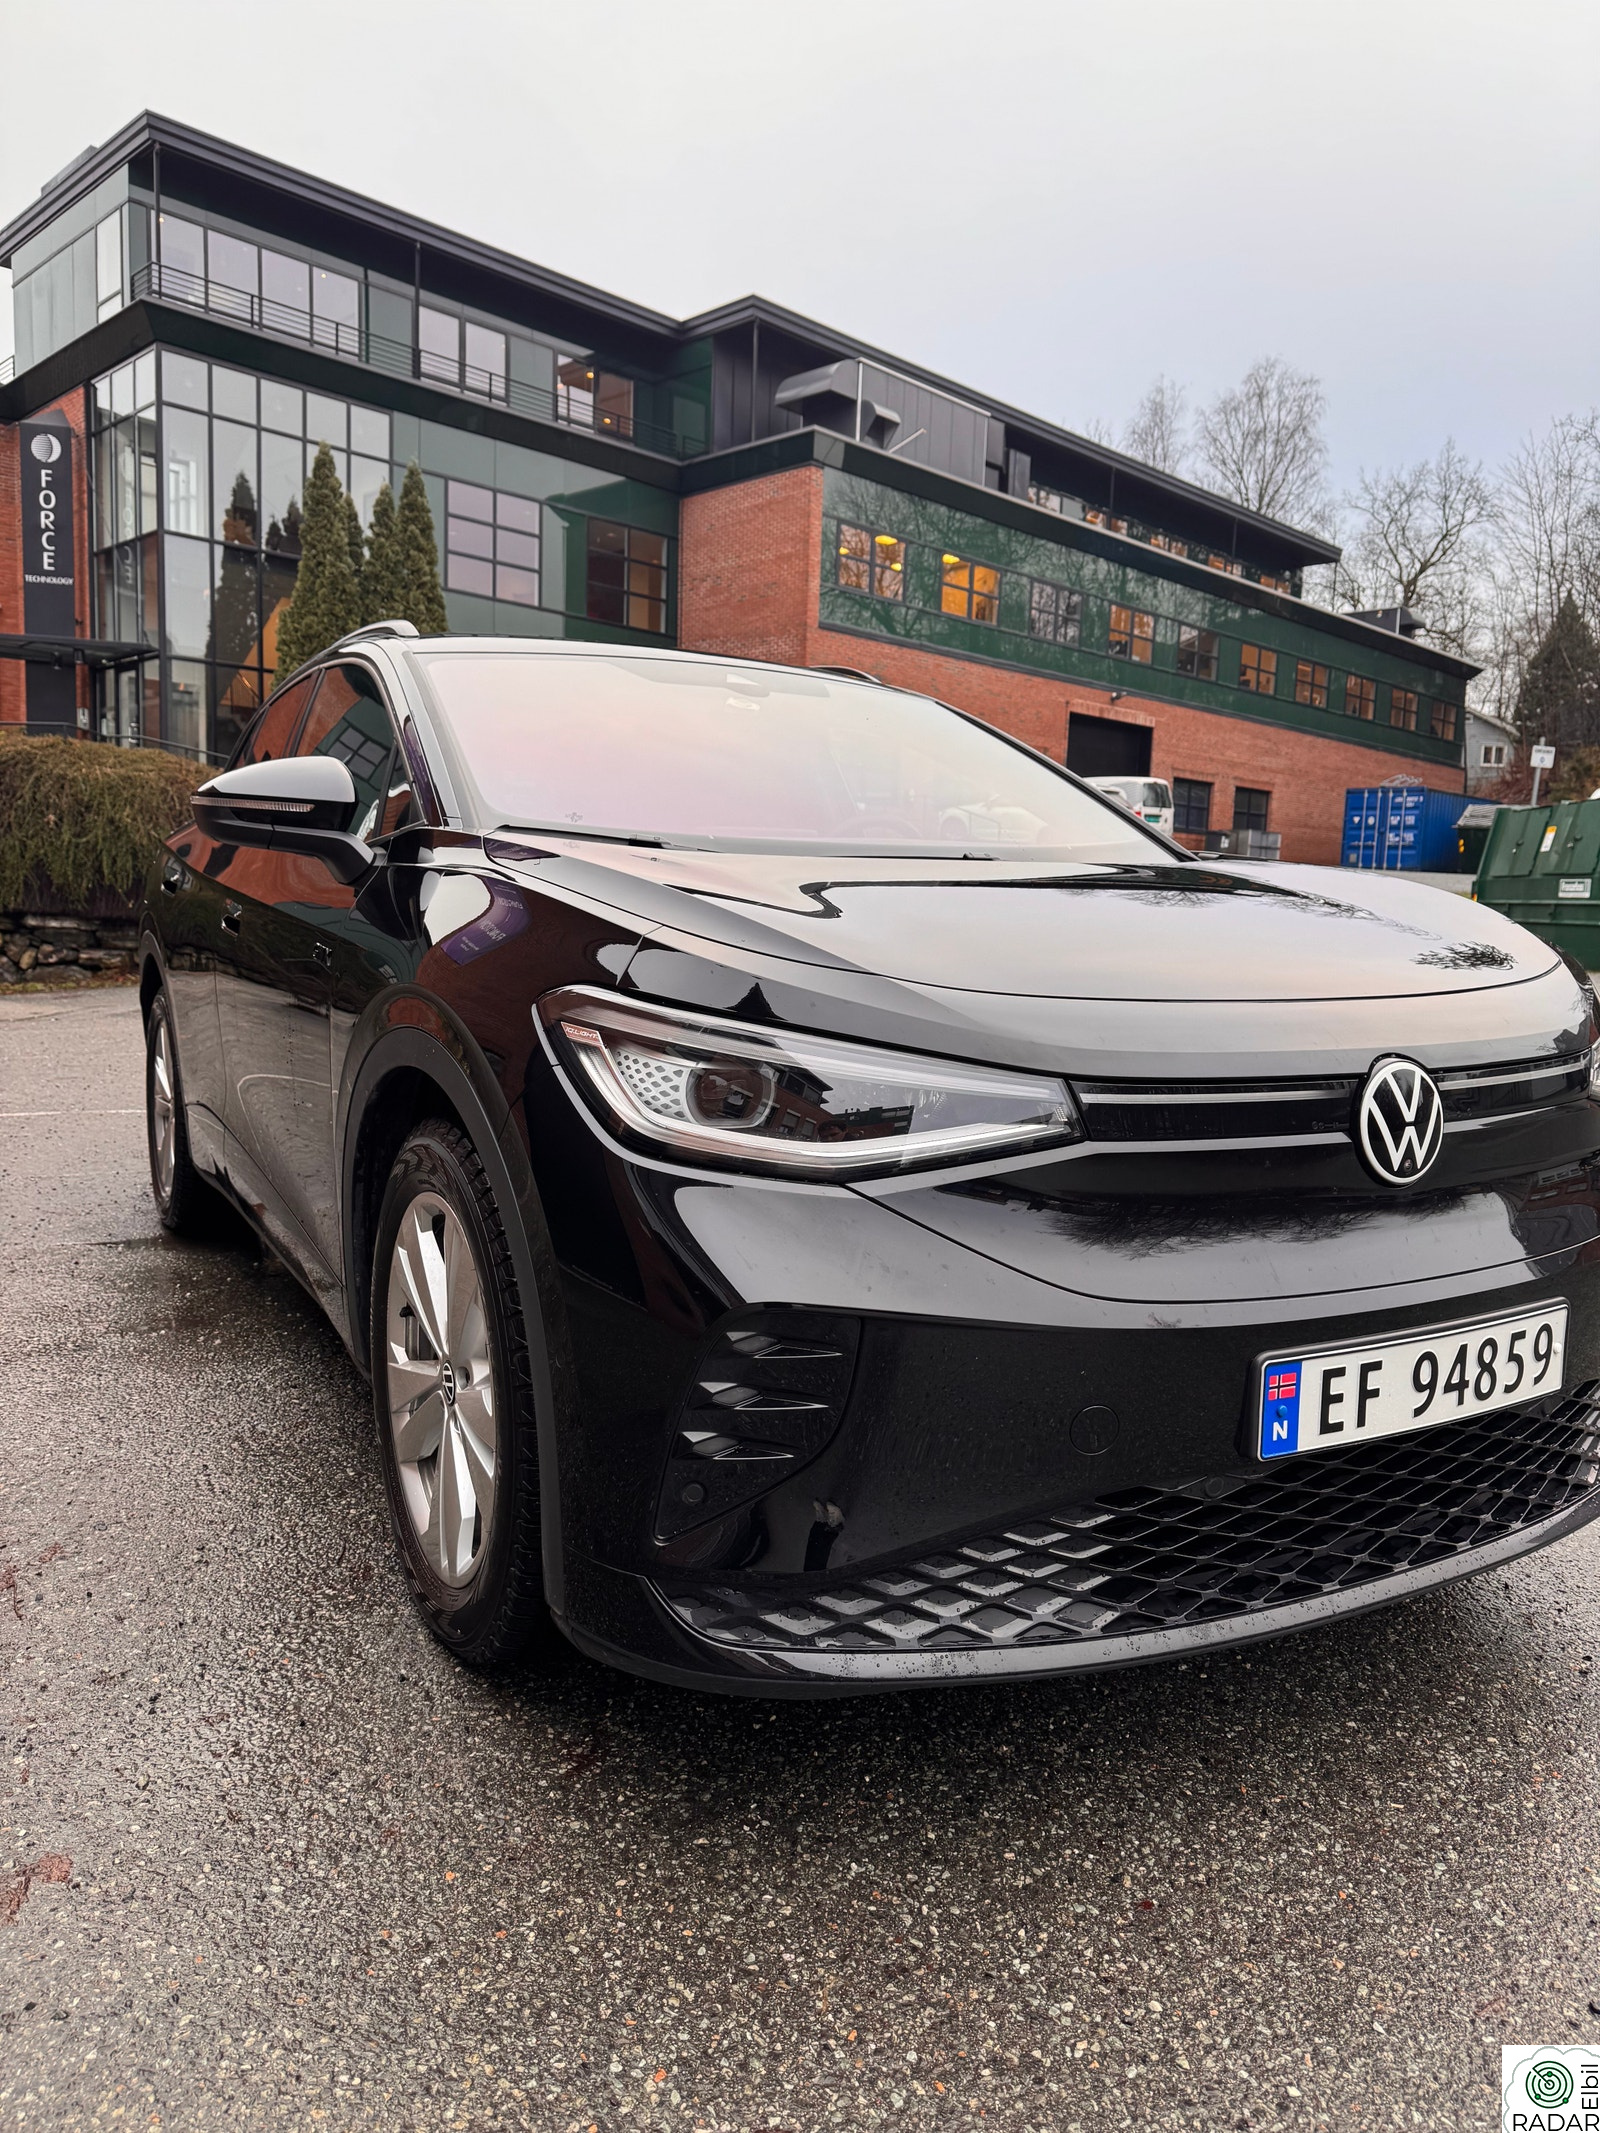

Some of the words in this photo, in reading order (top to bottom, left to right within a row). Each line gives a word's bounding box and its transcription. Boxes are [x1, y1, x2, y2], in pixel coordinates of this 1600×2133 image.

[39, 469, 56, 571] FORCE
[25, 574, 74, 585] TECHNOLOGY
[1362, 1063, 1442, 1178] VW
[1272, 1420, 1288, 1441] N
[1319, 1360, 1383, 1436] EF
[1412, 1323, 1554, 1418] 94859
